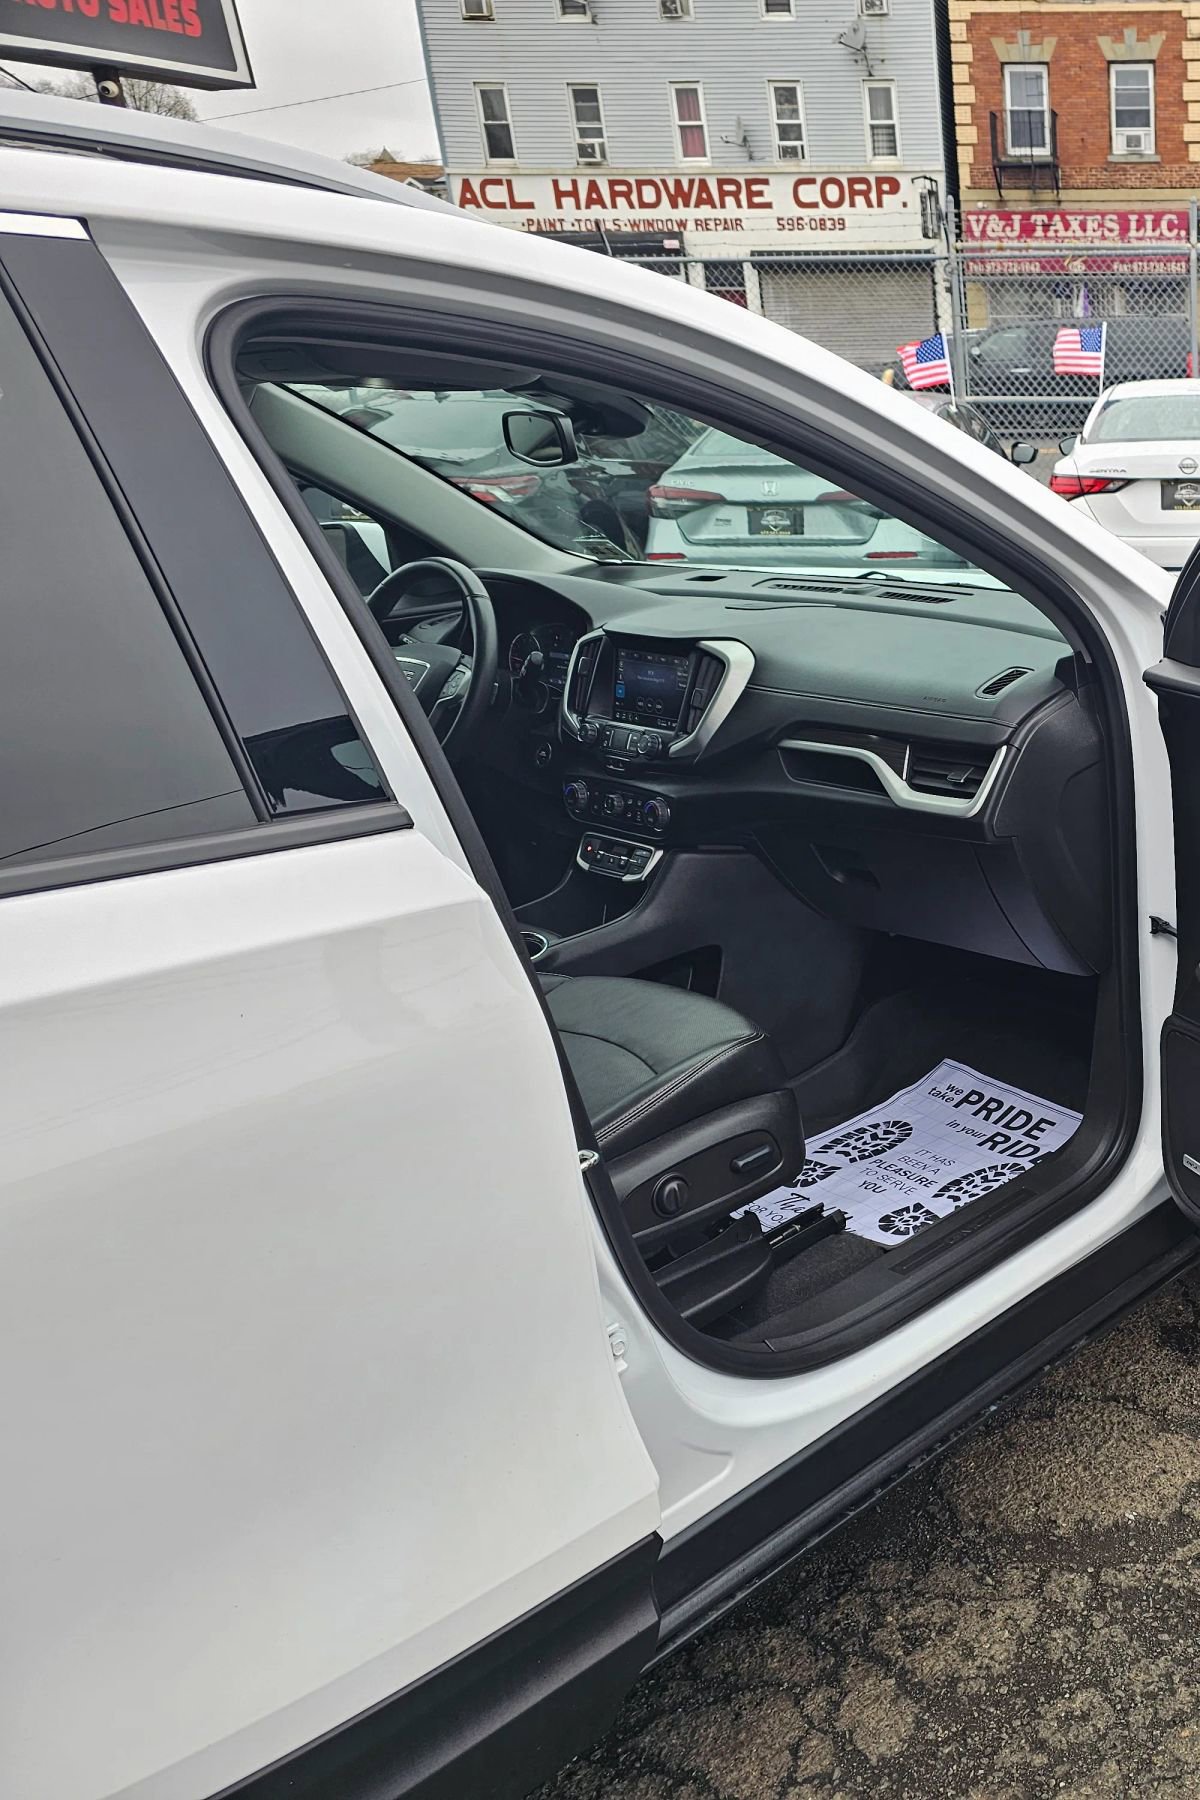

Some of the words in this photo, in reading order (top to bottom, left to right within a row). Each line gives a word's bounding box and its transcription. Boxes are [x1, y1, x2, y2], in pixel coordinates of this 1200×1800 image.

[109, 0, 202, 37] SALES
[458, 178, 535, 209] ACL
[552, 177, 773, 210] HARDWARE
[792, 176, 908, 209] CORP.
[694, 217, 745, 231] REPAIR
[967, 214, 1022, 237] V&J
[1031, 214, 1120, 237] TAXES
[1127, 214, 1187, 237] LLC.
[946, 1083, 964, 1096] we
[928, 1086, 955, 1103] take
[952, 1089, 1057, 1141] PRIDE
[945, 1119, 960, 1129] in
[956, 1125, 988, 1139] your
[897, 1155, 931, 1171] BEEN
[915, 1149, 932, 1157] IT
[928, 1154, 956, 1167] HAS
[860, 1167, 878, 1176] TO
[876, 1174, 918, 1196] SERVE
[868, 1158, 939, 1188] PLEASURE
[858, 1180, 887, 1194] YOU
